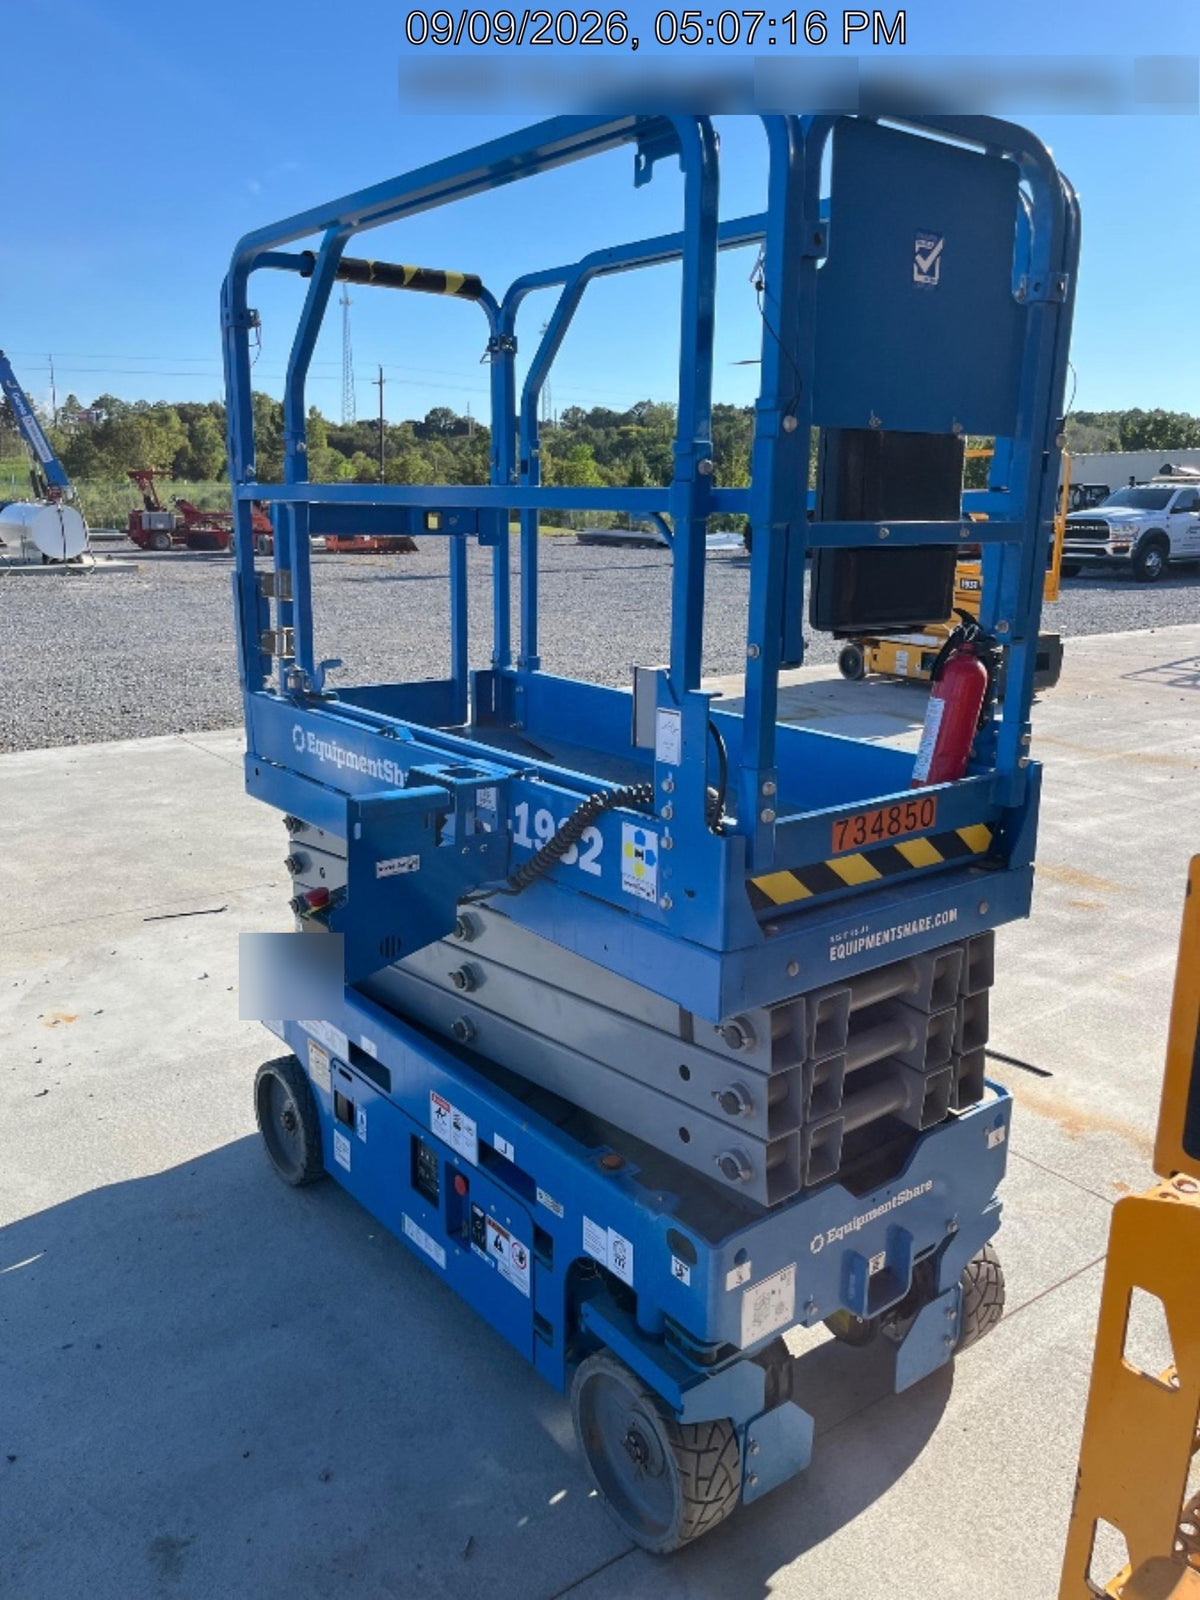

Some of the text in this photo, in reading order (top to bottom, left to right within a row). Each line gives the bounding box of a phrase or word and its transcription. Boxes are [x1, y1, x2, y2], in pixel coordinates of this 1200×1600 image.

[835, 797, 935, 851] 734850
[829, 907, 959, 962] EQUIPMENTSHARE.COM
[826, 1180, 933, 1245] EquipmentShare
